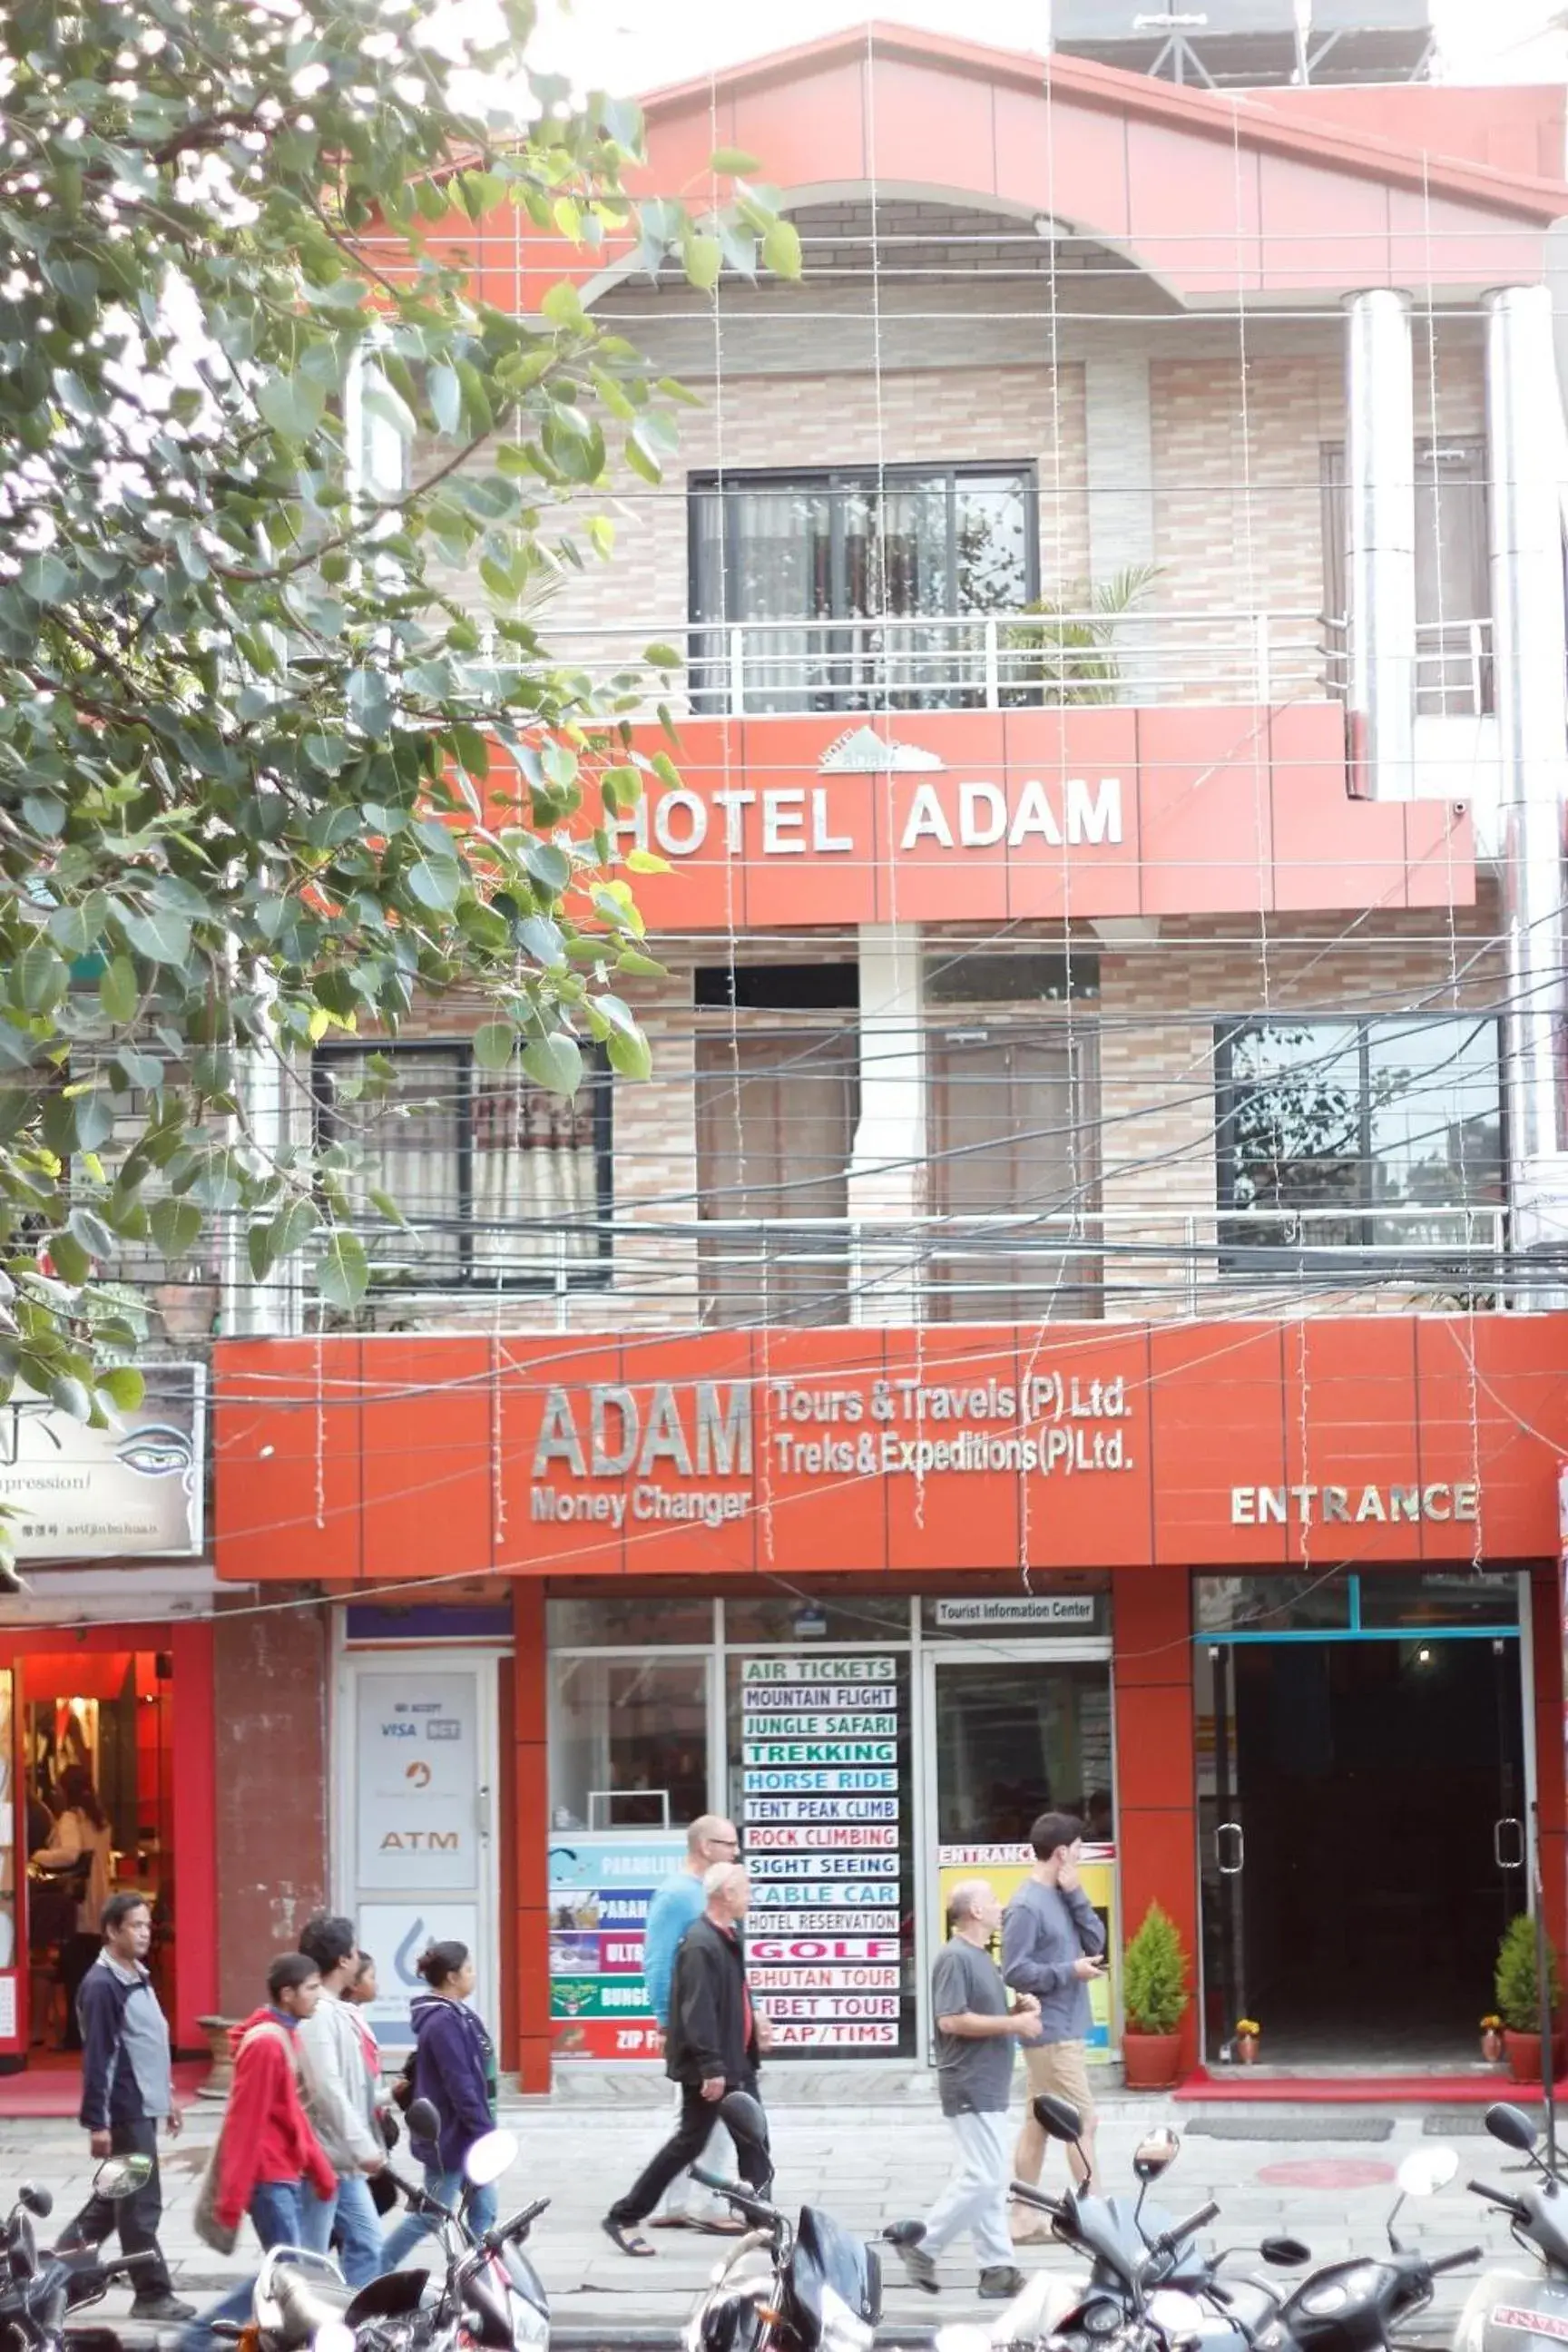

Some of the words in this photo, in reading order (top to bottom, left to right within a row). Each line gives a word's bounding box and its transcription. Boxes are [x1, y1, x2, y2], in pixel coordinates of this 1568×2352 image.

[606, 788, 853, 857] HOTEL
[900, 778, 1122, 849] ADAM
[771, 1380, 864, 1422] Tours
[1071, 1376, 1132, 1418] Ltd.
[532, 1380, 753, 1477] ADAM
[530, 1485, 627, 1529] Money
[632, 1483, 752, 1528] Changer
[1230, 1482, 1479, 1525] ENTRANCE
[940, 1603, 981, 1619] Tourist
[984, 1602, 1050, 1619] Information
[1053, 1601, 1092, 1617] Center
[748, 1662, 787, 1679] AIR
[797, 1661, 892, 1679] TICKETS
[747, 1690, 831, 1707] MOUNTAIN
[837, 1688, 892, 1706] FLIGHT
[381, 1723, 417, 1737] VISA
[747, 1717, 818, 1735] JUNGLE
[825, 1716, 894, 1734] SAFARI
[749, 1743, 894, 1762] TREKKING
[748, 1771, 828, 1789] HORSE
[838, 1770, 895, 1788] RIDE
[749, 1801, 791, 1818] TENT
[798, 1801, 840, 1818] PEAK
[846, 1800, 895, 1818] CLIMB
[379, 1831, 460, 1850] ATM
[749, 1829, 799, 1847] ROCK
[805, 1828, 895, 1846] CLIMBING
[750, 1857, 812, 1874] SIGHT
[820, 1857, 895, 1874] SEEING
[751, 1886, 833, 1904] CABLE
[844, 1885, 895, 1903] CAR
[599, 1900, 651, 1919] PARAH
[749, 1914, 794, 1930] HOTEL
[799, 1913, 896, 1930] RESERVATION
[606, 1943, 645, 1962] ULTR
[750, 1941, 897, 1959] GOLF
[750, 1970, 832, 1987] BHUTAN
[841, 1969, 896, 1986] TOUR
[601, 1987, 651, 2007] BUNGE
[756, 1997, 820, 2016] IBET
[830, 1997, 896, 2016] TOUR
[616, 2029, 643, 2050] ZIP
[645, 2029, 661, 2050] F
